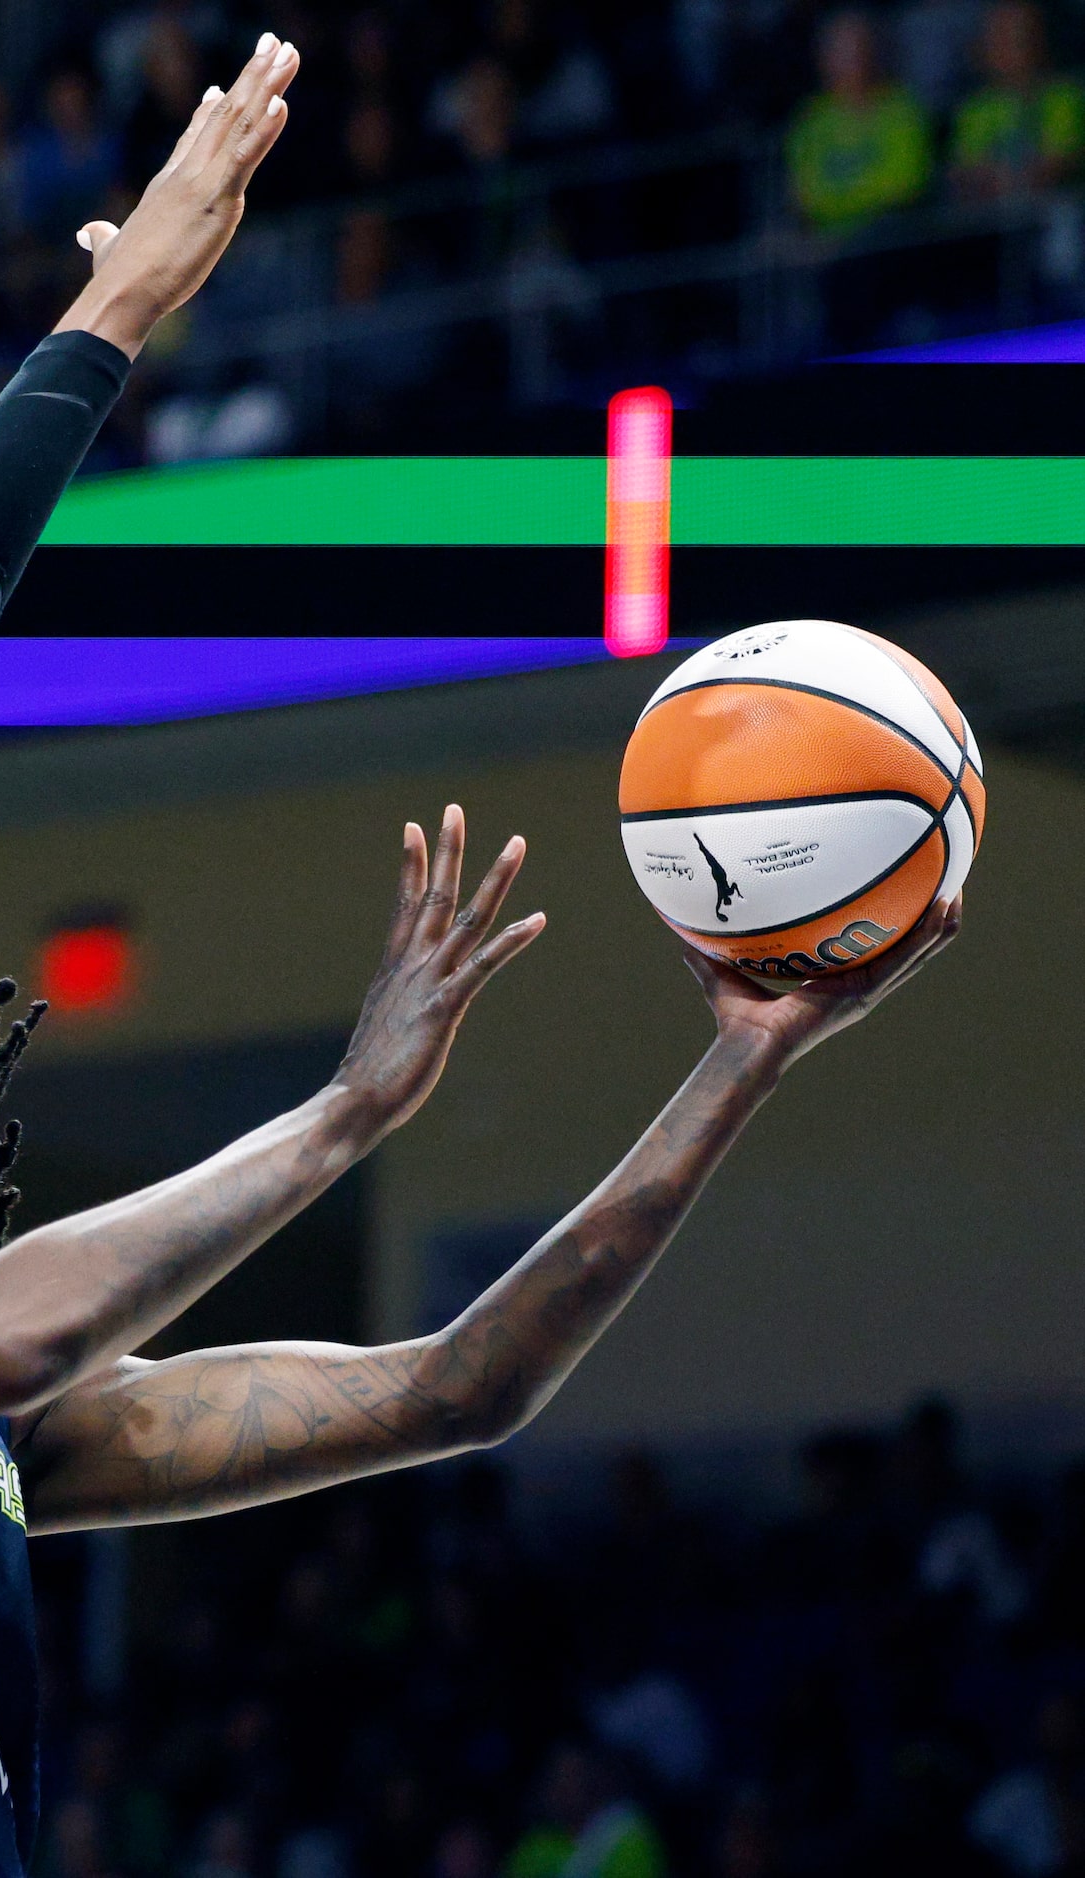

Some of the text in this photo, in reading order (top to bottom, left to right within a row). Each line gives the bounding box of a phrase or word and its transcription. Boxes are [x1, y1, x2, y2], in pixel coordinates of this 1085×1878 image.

[743, 843, 820, 867] GAME BALL
[755, 856, 814, 875] OFFICIAL
